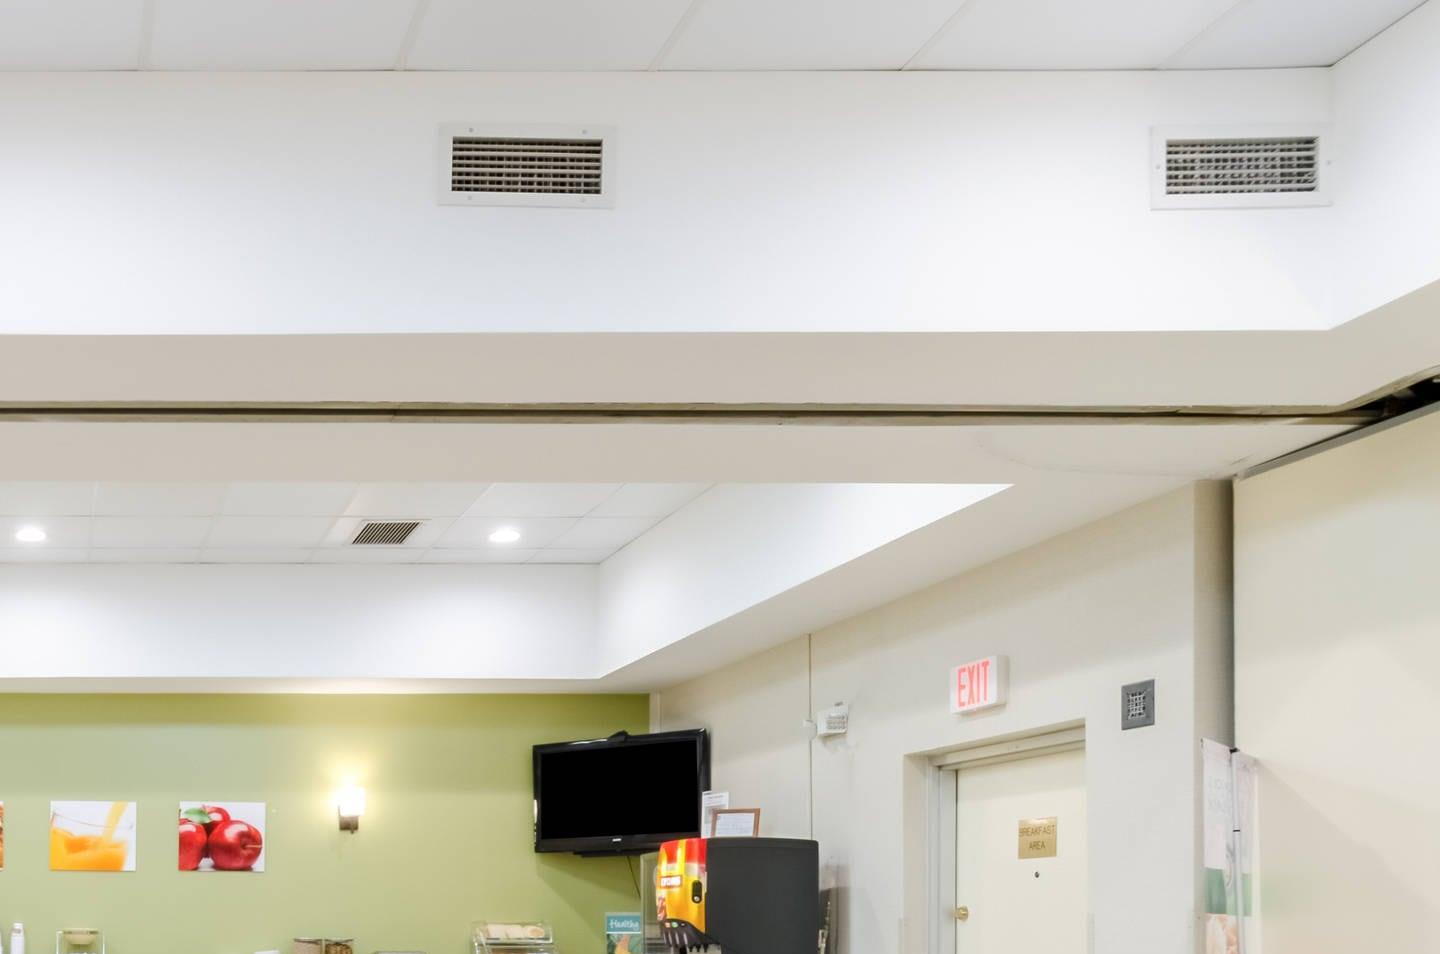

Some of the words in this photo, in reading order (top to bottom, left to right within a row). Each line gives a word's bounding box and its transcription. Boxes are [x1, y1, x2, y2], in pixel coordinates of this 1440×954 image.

[957, 660, 990, 708] EXIT
[1018, 824, 1056, 838] BREAKFAST
[1029, 840, 1046, 851] AREA
[609, 918, 640, 931] Healthy
